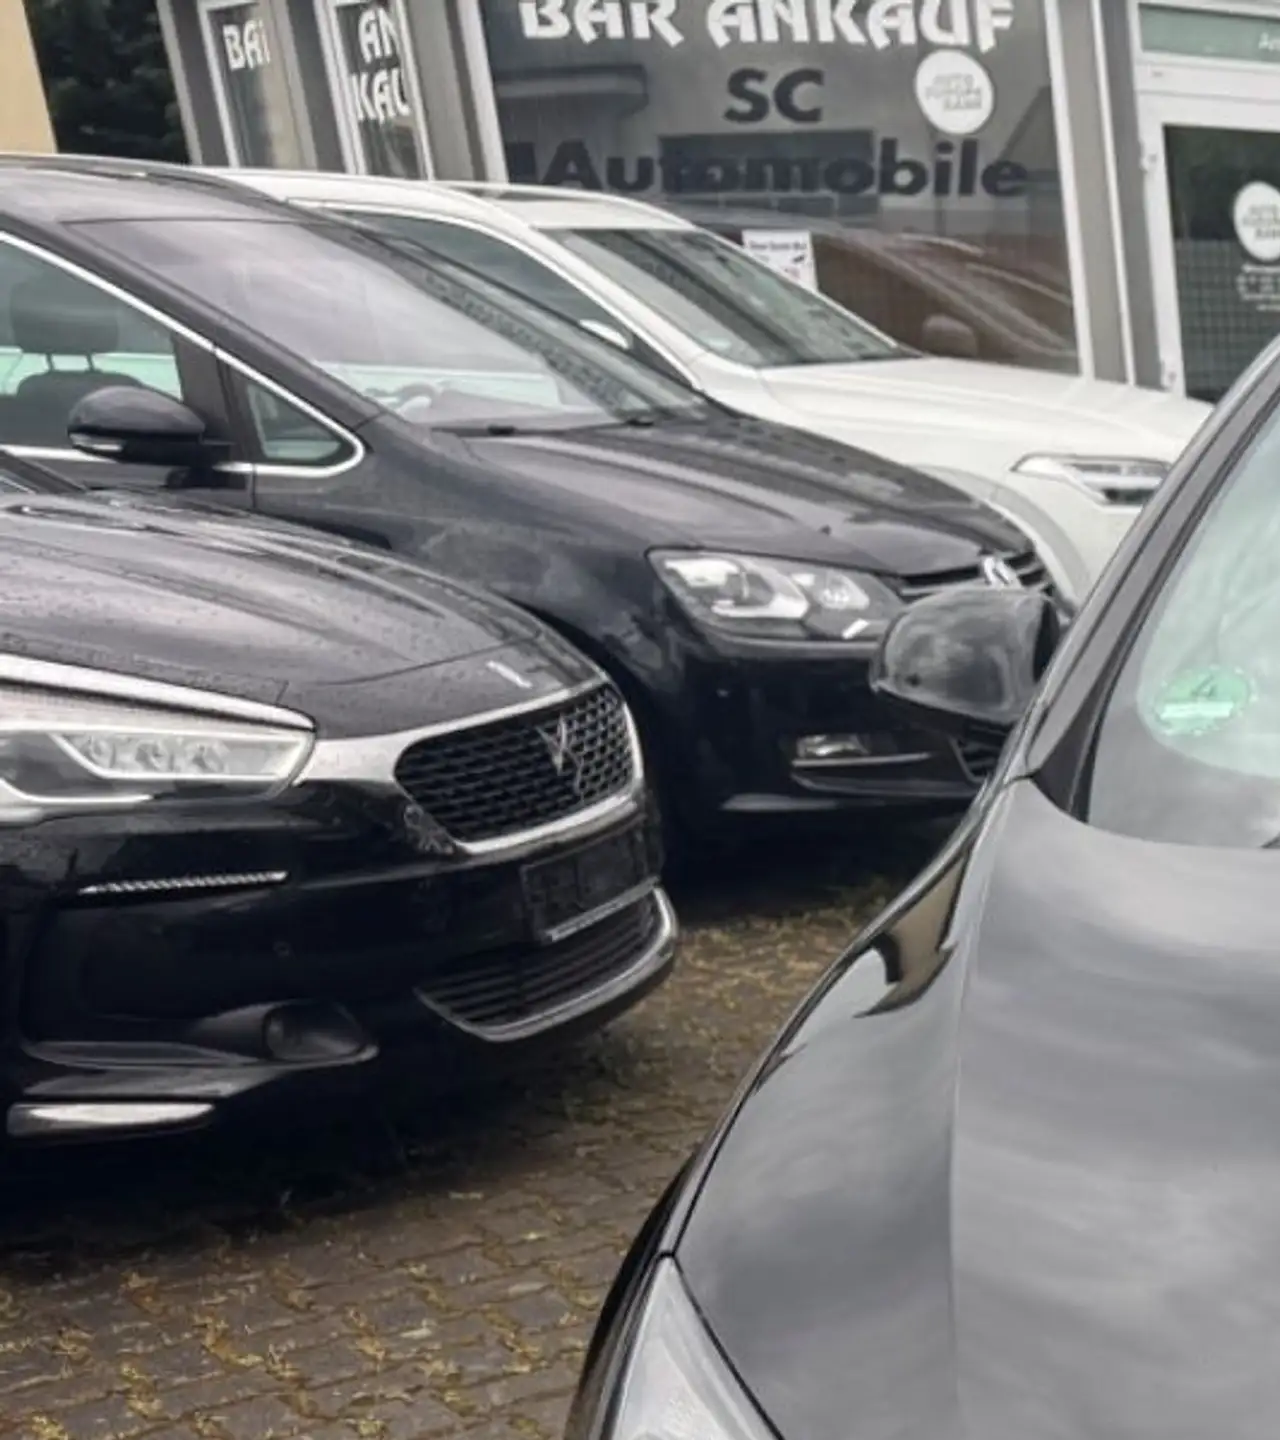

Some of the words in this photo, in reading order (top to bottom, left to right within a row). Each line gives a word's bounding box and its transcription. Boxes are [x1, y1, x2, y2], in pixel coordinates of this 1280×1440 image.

[518, 0, 685, 48] BAR
[706, 0, 1014, 52] ANKAUF
[724, 67, 827, 123] SC
